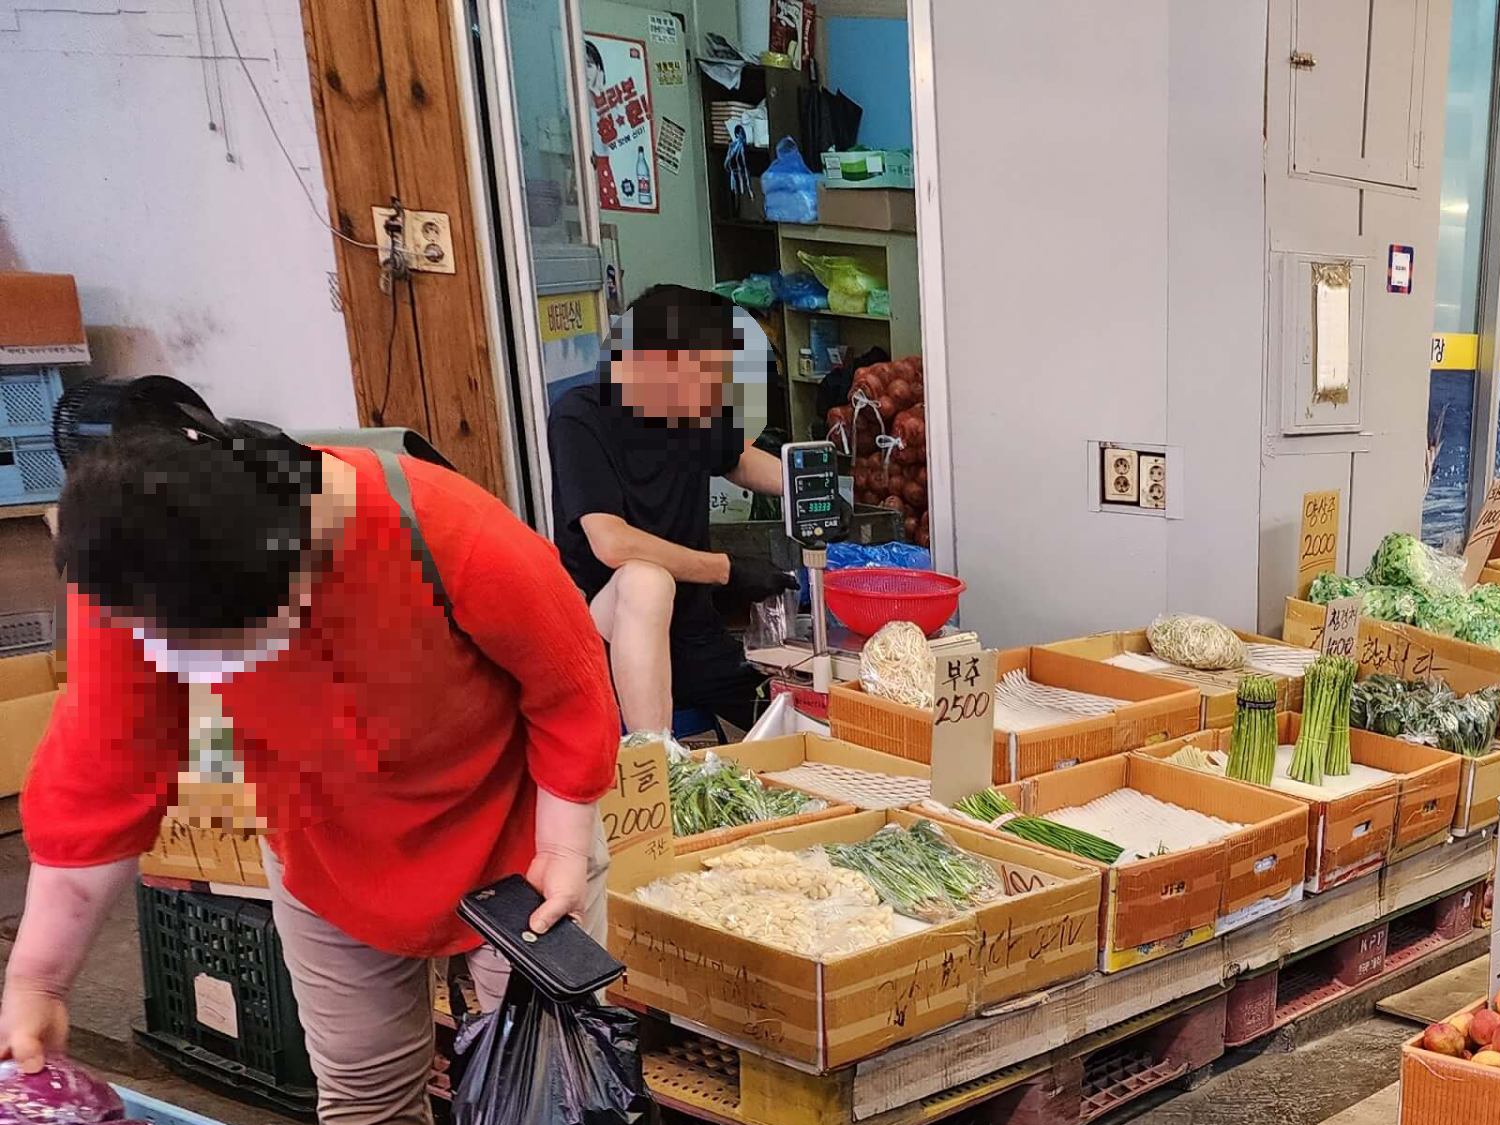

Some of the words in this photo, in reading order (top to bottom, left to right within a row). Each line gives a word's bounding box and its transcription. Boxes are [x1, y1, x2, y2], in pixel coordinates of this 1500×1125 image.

[1430, 337, 1446, 364] 장
[1301, 532, 1337, 561] 2000
[941, 655, 982, 692] 부추
[934, 691, 990, 727] 2500
[602, 800, 667, 843] 2000
